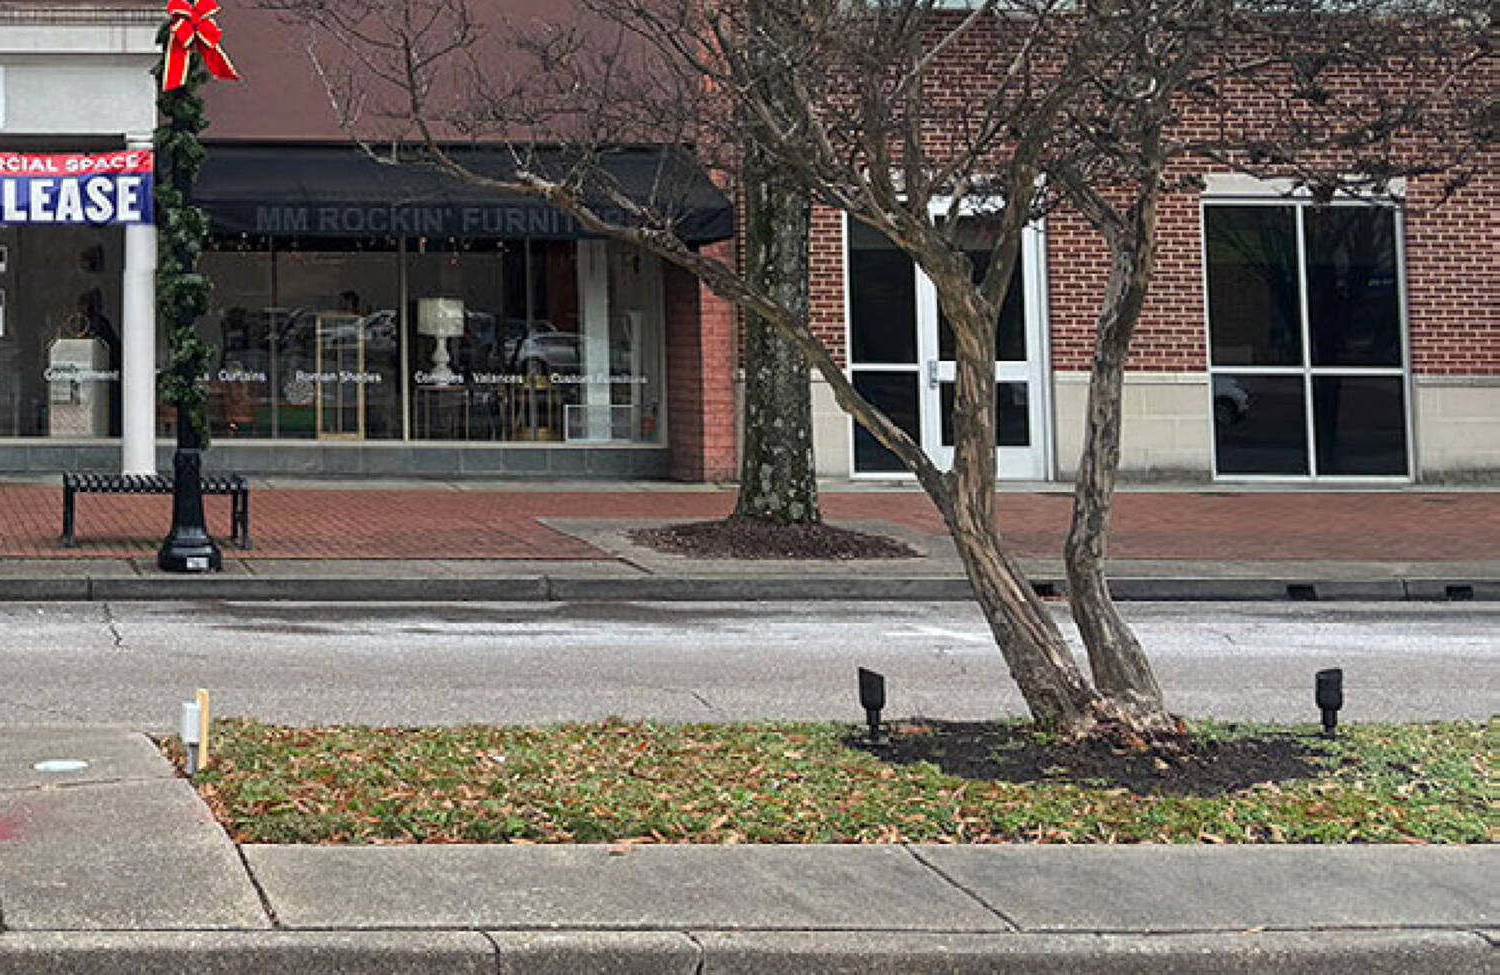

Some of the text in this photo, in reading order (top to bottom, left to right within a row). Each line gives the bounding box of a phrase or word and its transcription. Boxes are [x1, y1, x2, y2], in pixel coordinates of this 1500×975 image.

[65, 153, 139, 173] SPACE
[3, 176, 142, 223] LEASE
[255, 207, 309, 230] MM
